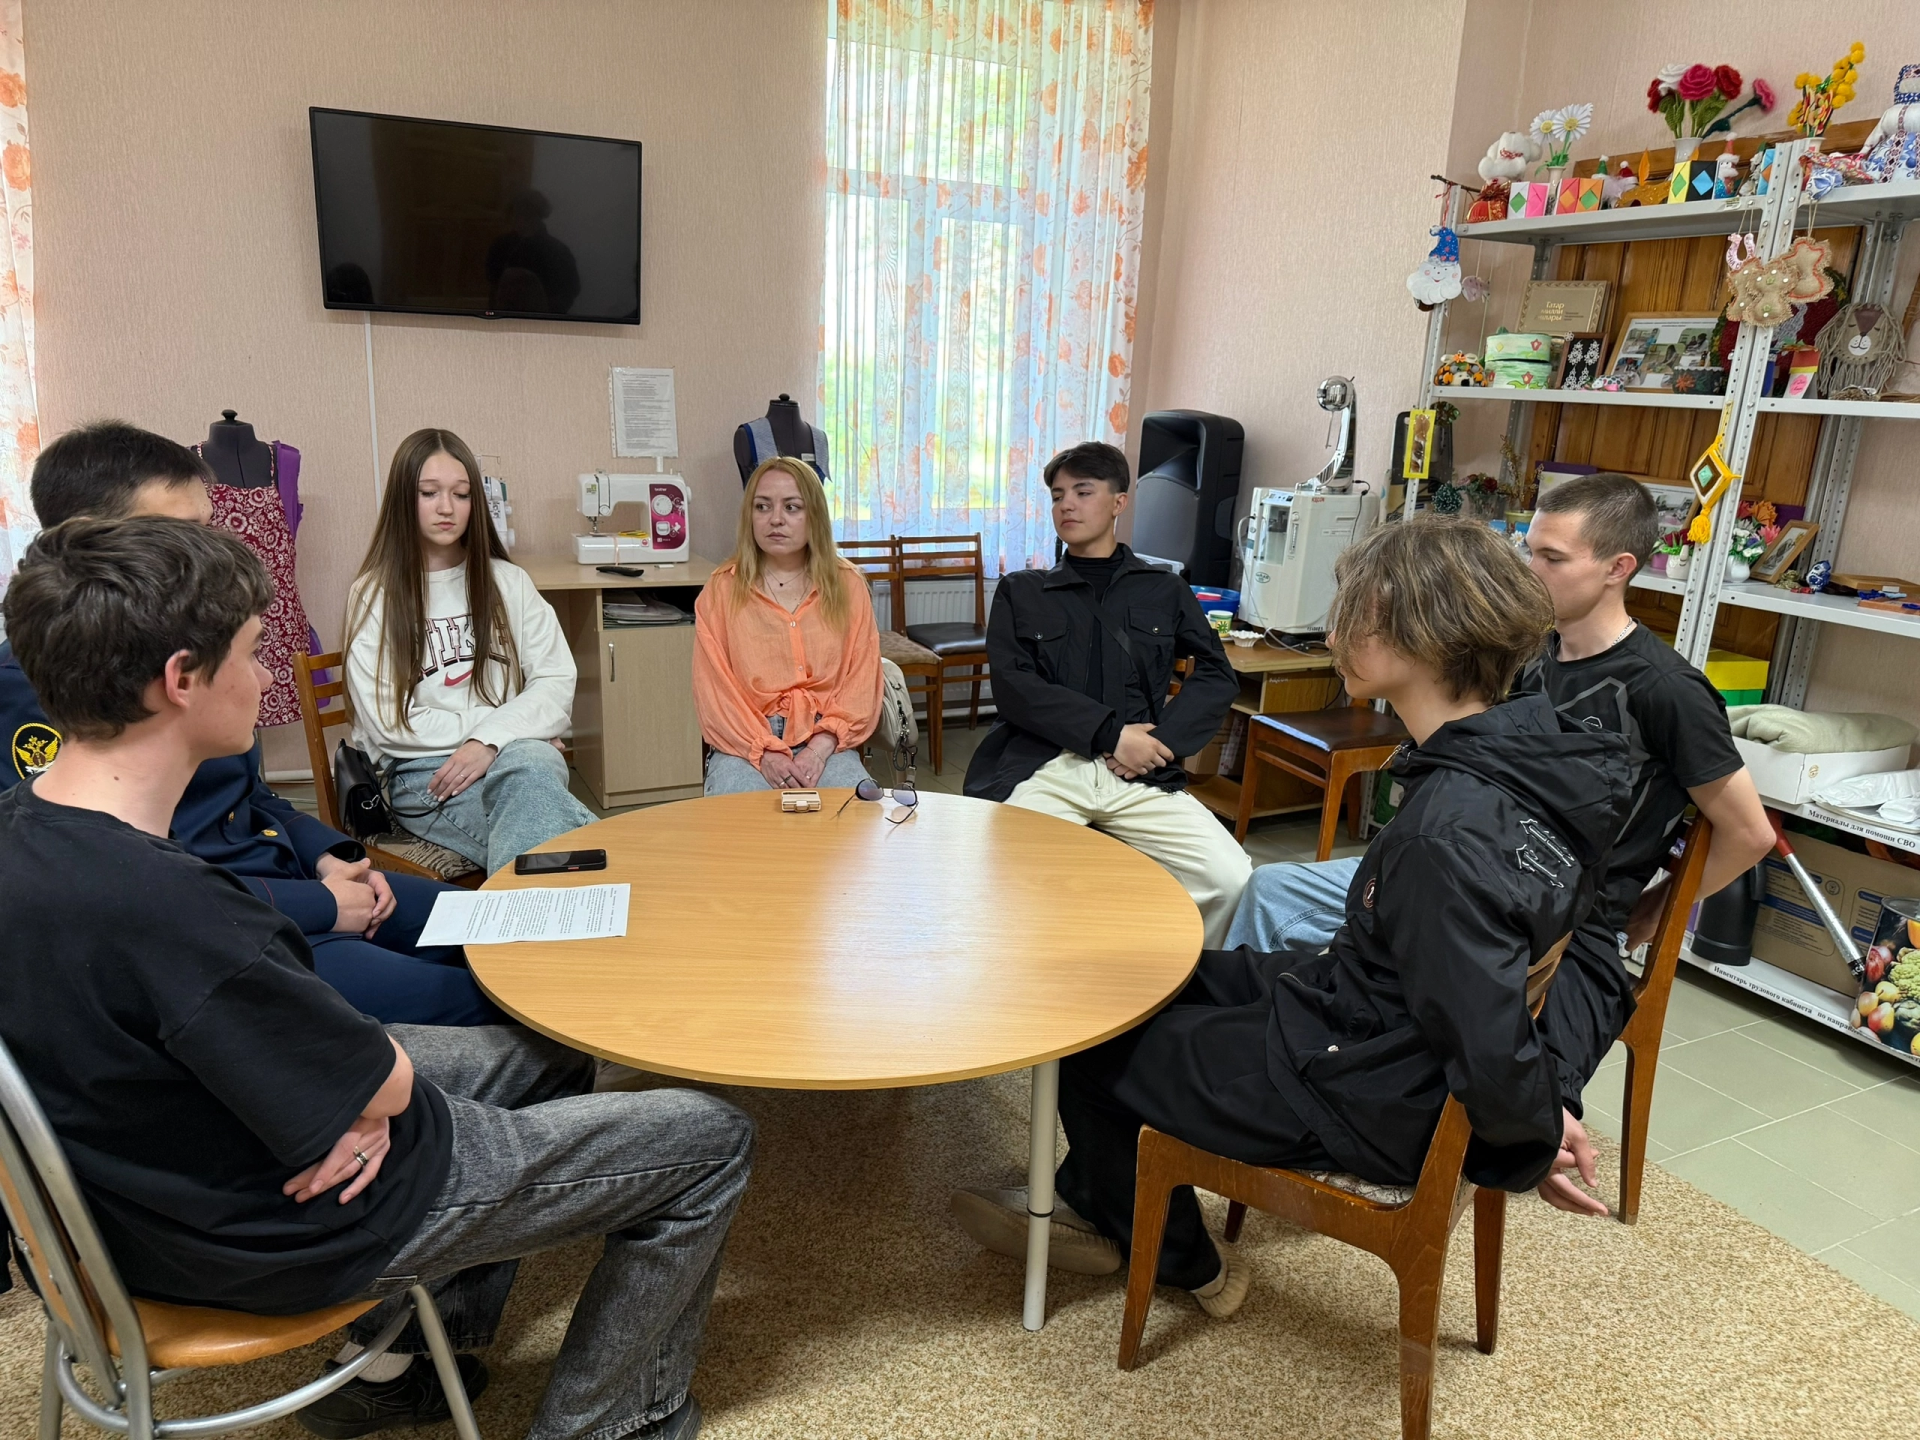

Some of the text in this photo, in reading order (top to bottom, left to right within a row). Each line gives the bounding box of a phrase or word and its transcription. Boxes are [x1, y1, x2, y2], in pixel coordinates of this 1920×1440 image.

[1546, 301, 1565, 309] Татар
[1808, 809, 1849, 828] Материалы
[1850, 824, 1864, 832] для
[1897, 837, 1916, 848] СВО
[1714, 965, 1747, 986] Инвентарь
[1781, 996, 1812, 1014] кабинета
[1817, 1011, 1826, 1019] по
